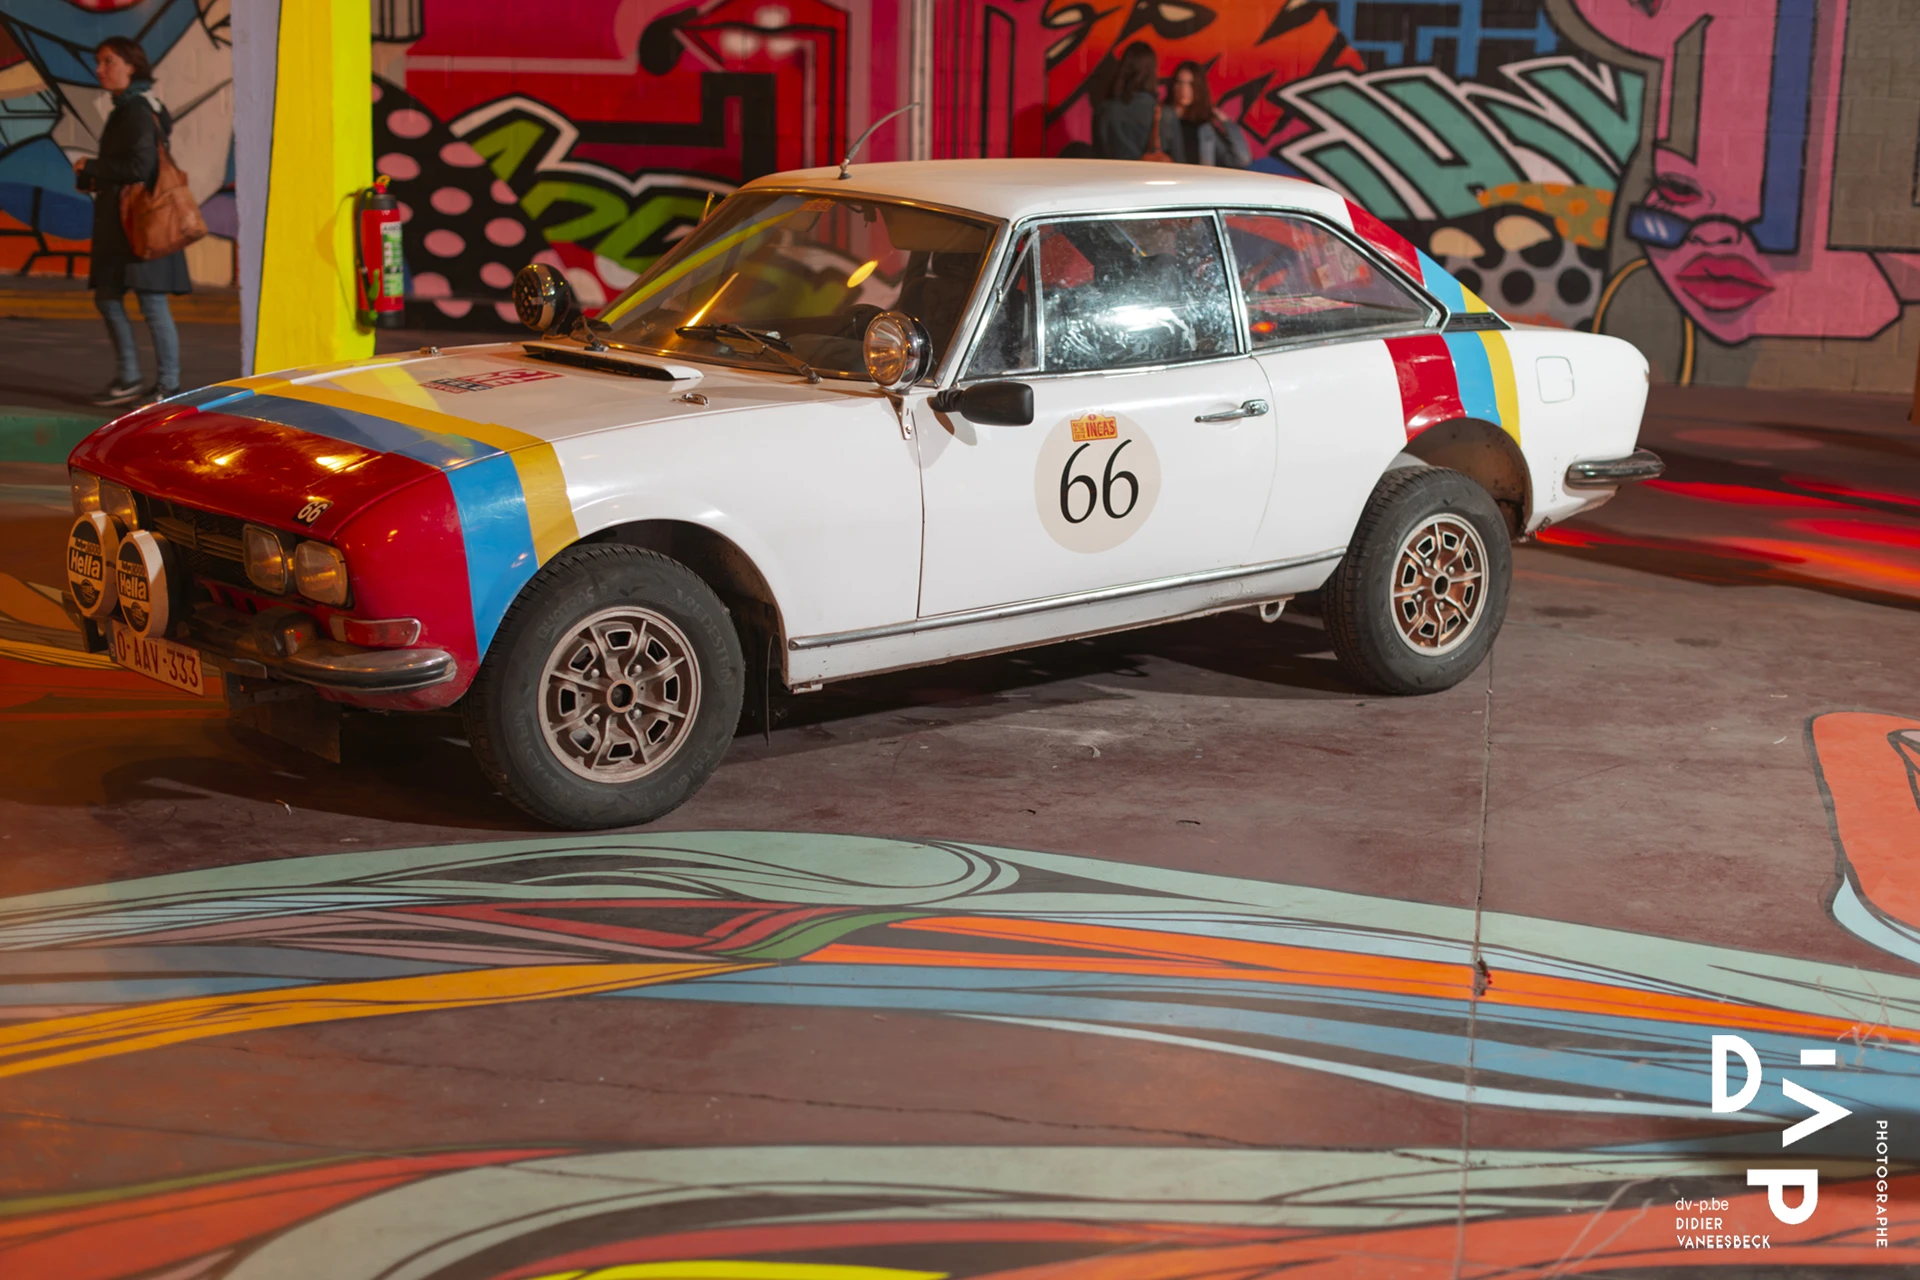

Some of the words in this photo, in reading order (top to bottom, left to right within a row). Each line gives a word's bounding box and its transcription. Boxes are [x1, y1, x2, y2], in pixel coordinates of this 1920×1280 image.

[1086, 420, 1115, 438] INCAS
[1060, 439, 1139, 524] 66
[297, 501, 329, 523] 66
[70, 550, 101, 578] Hella
[119, 572, 148, 600] Hella
